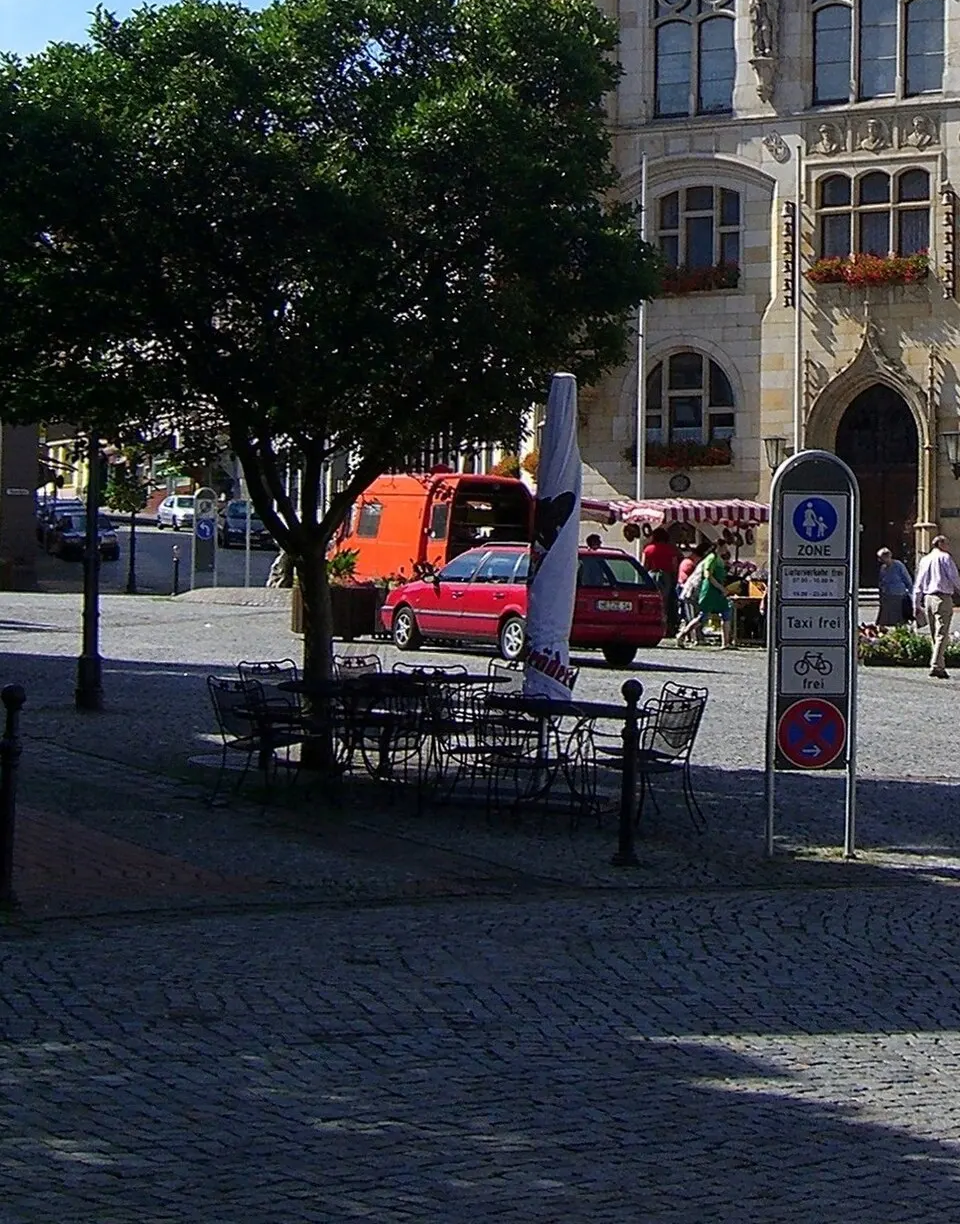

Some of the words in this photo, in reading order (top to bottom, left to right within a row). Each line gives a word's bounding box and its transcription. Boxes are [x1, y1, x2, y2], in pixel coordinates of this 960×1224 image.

[797, 544, 831, 556] ZONE
[787, 616, 813, 629] Taxi
[818, 616, 841, 629] frei
[802, 678, 825, 689] frei
